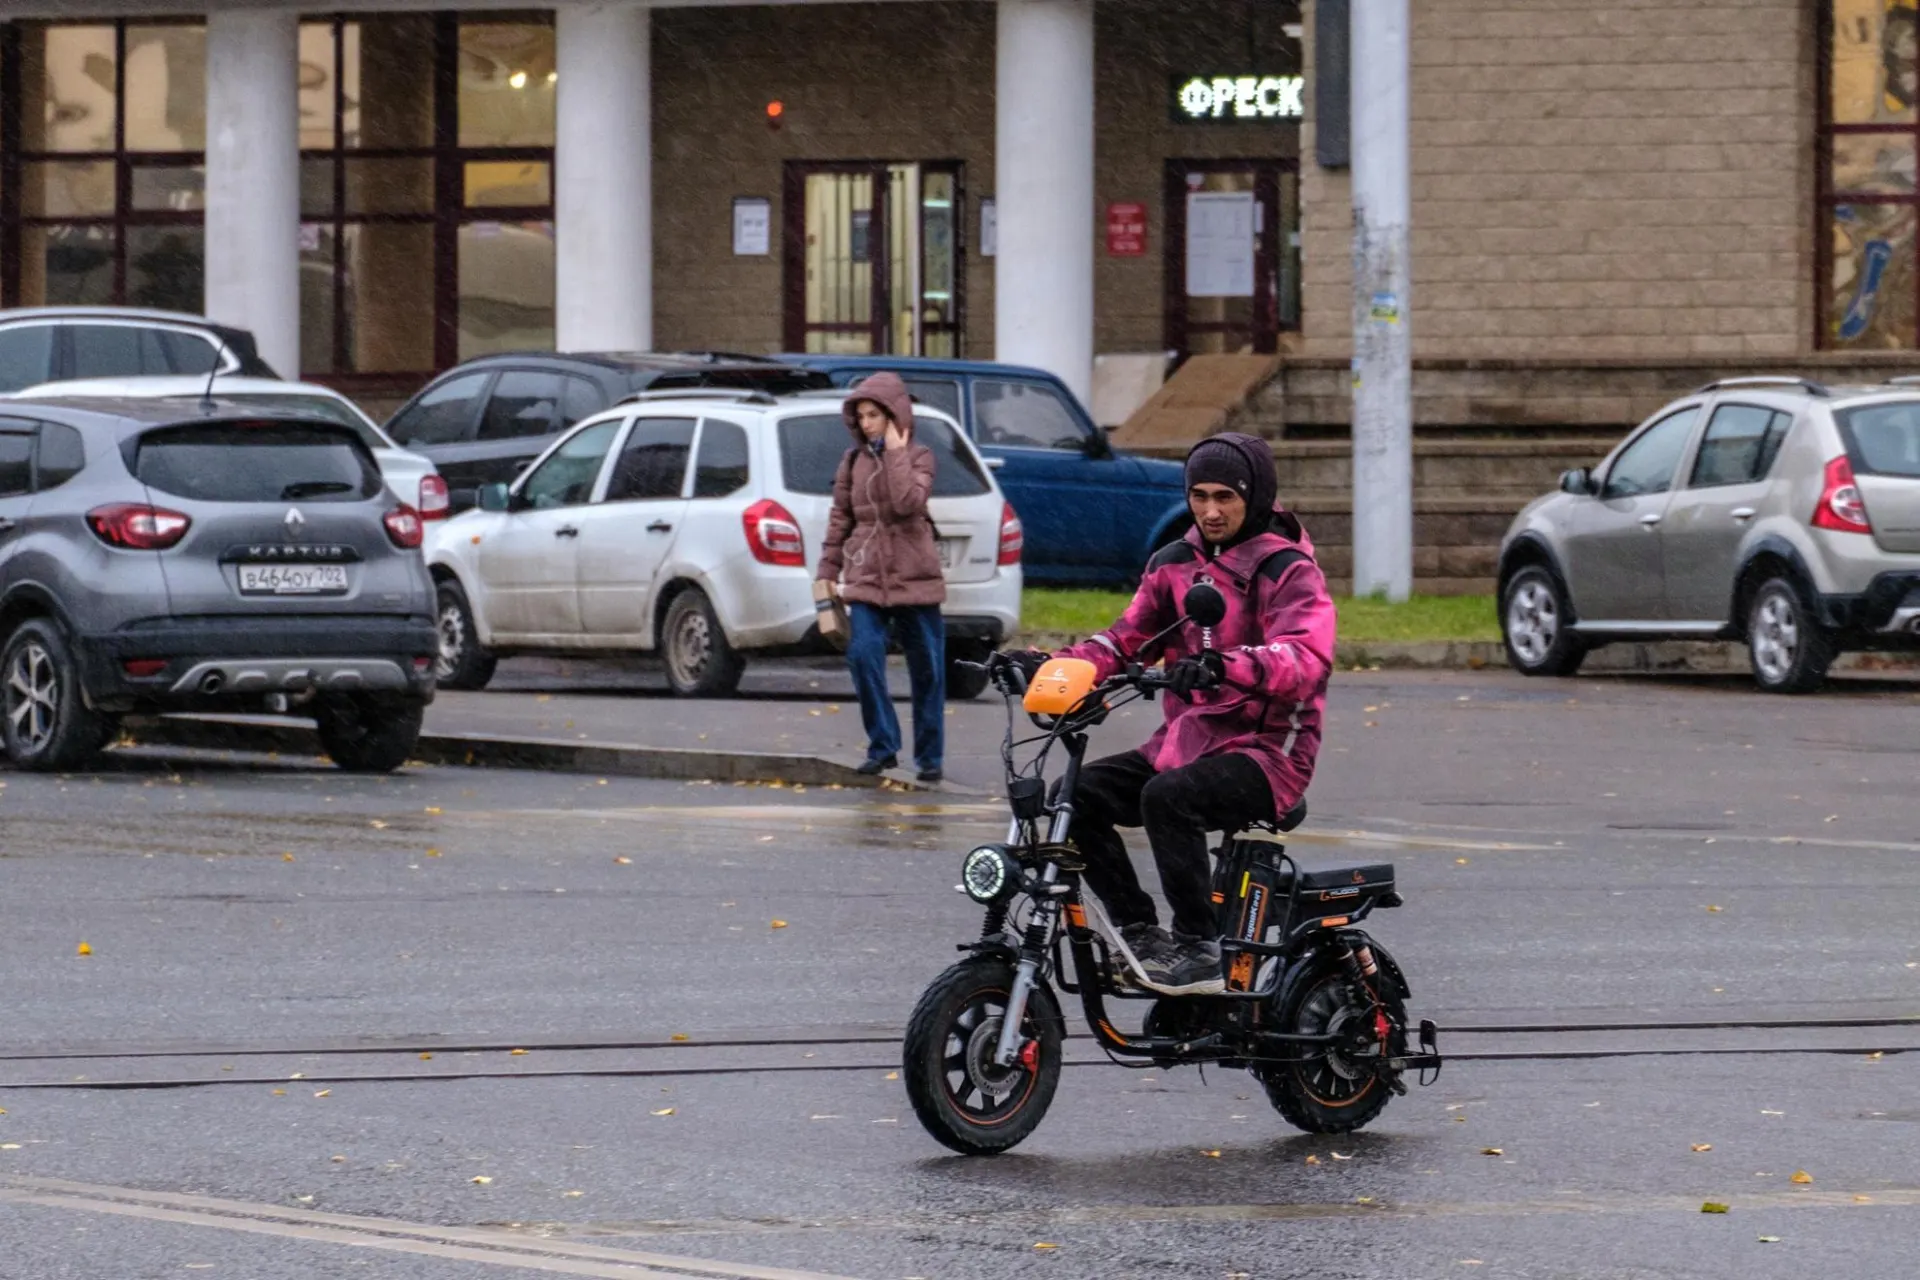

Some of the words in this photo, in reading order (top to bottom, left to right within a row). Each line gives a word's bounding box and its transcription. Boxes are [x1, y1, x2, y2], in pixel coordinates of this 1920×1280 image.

[1178, 76, 1305, 117] ФРЕСК
[249, 546, 342, 556] KAPTUR
[316, 566, 341, 581] 702
